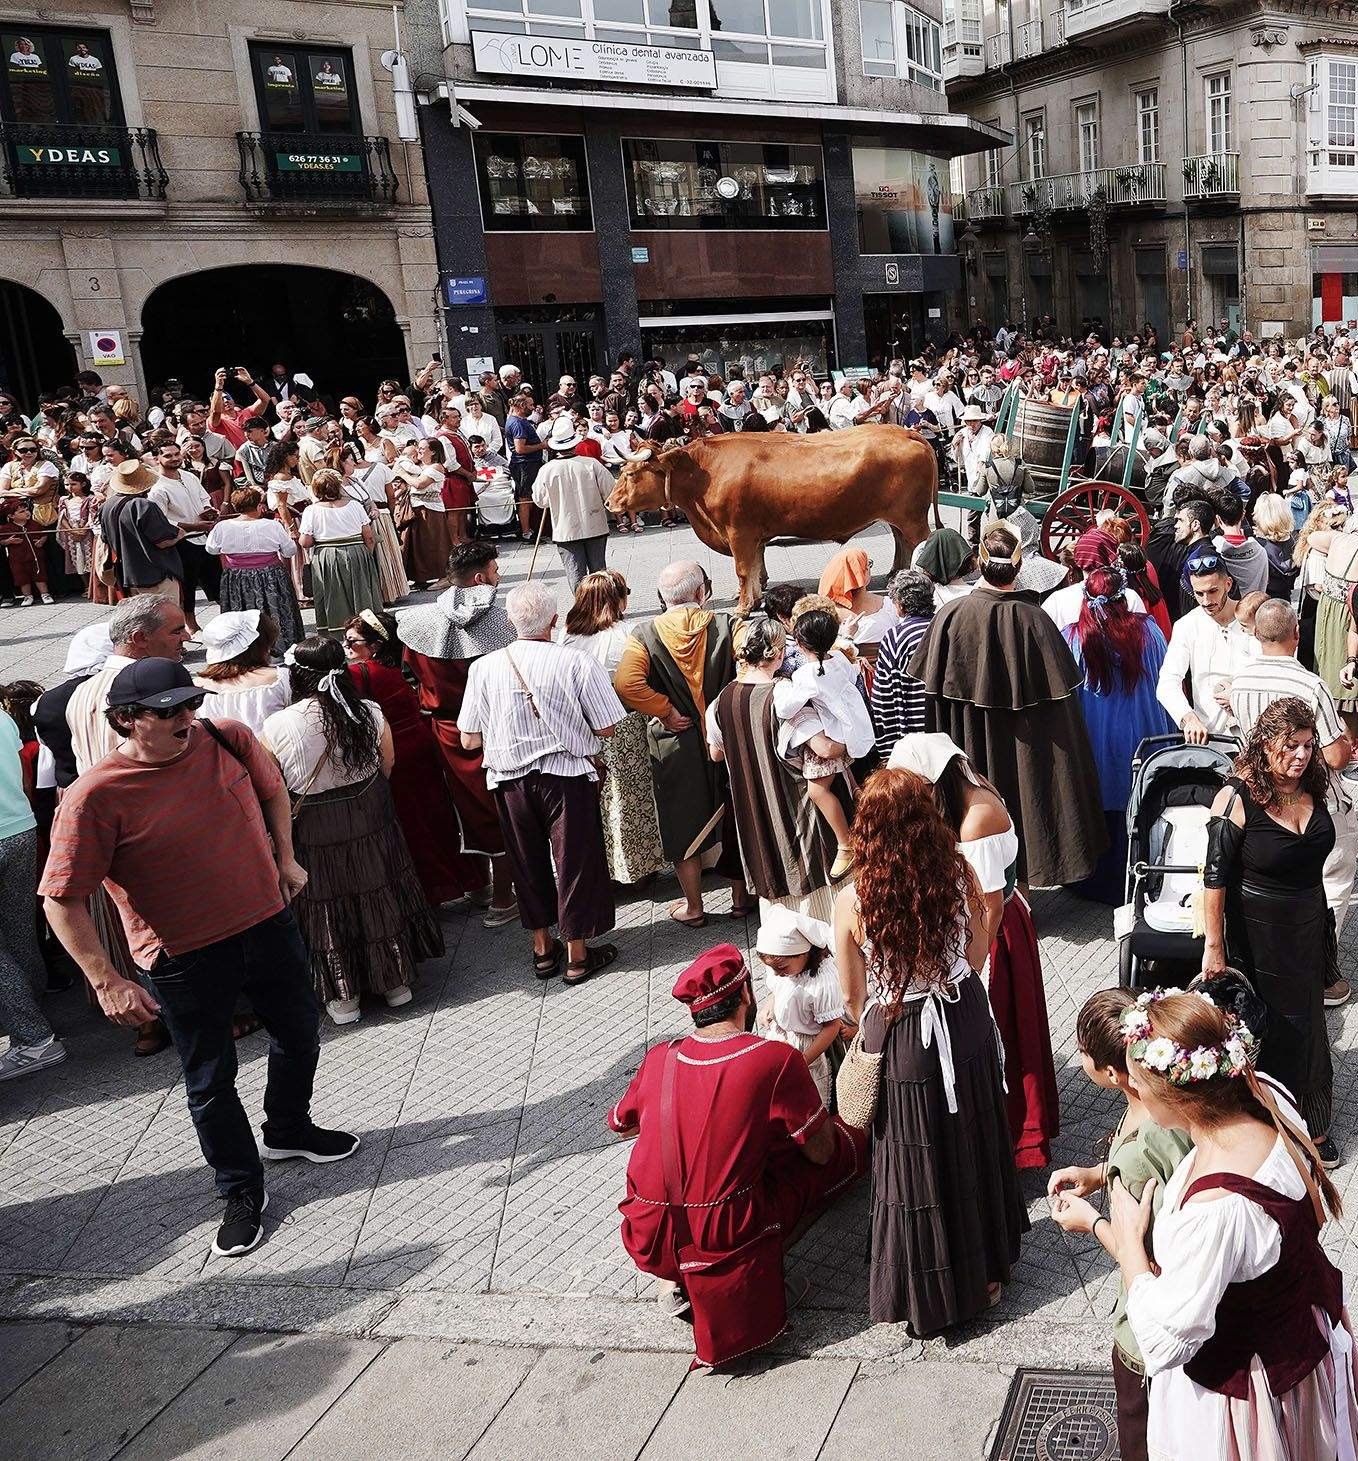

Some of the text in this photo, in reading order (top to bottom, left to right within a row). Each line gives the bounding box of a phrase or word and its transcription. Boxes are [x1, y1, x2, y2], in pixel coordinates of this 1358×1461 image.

[517, 43, 585, 70] LOME
[592, 43, 710, 63] Clínica dental avanzada
[28, 148, 110, 164] YDEAS
[288, 155, 306, 163] 626
[332, 156, 341, 164] 31
[88, 276, 101, 292] 3
